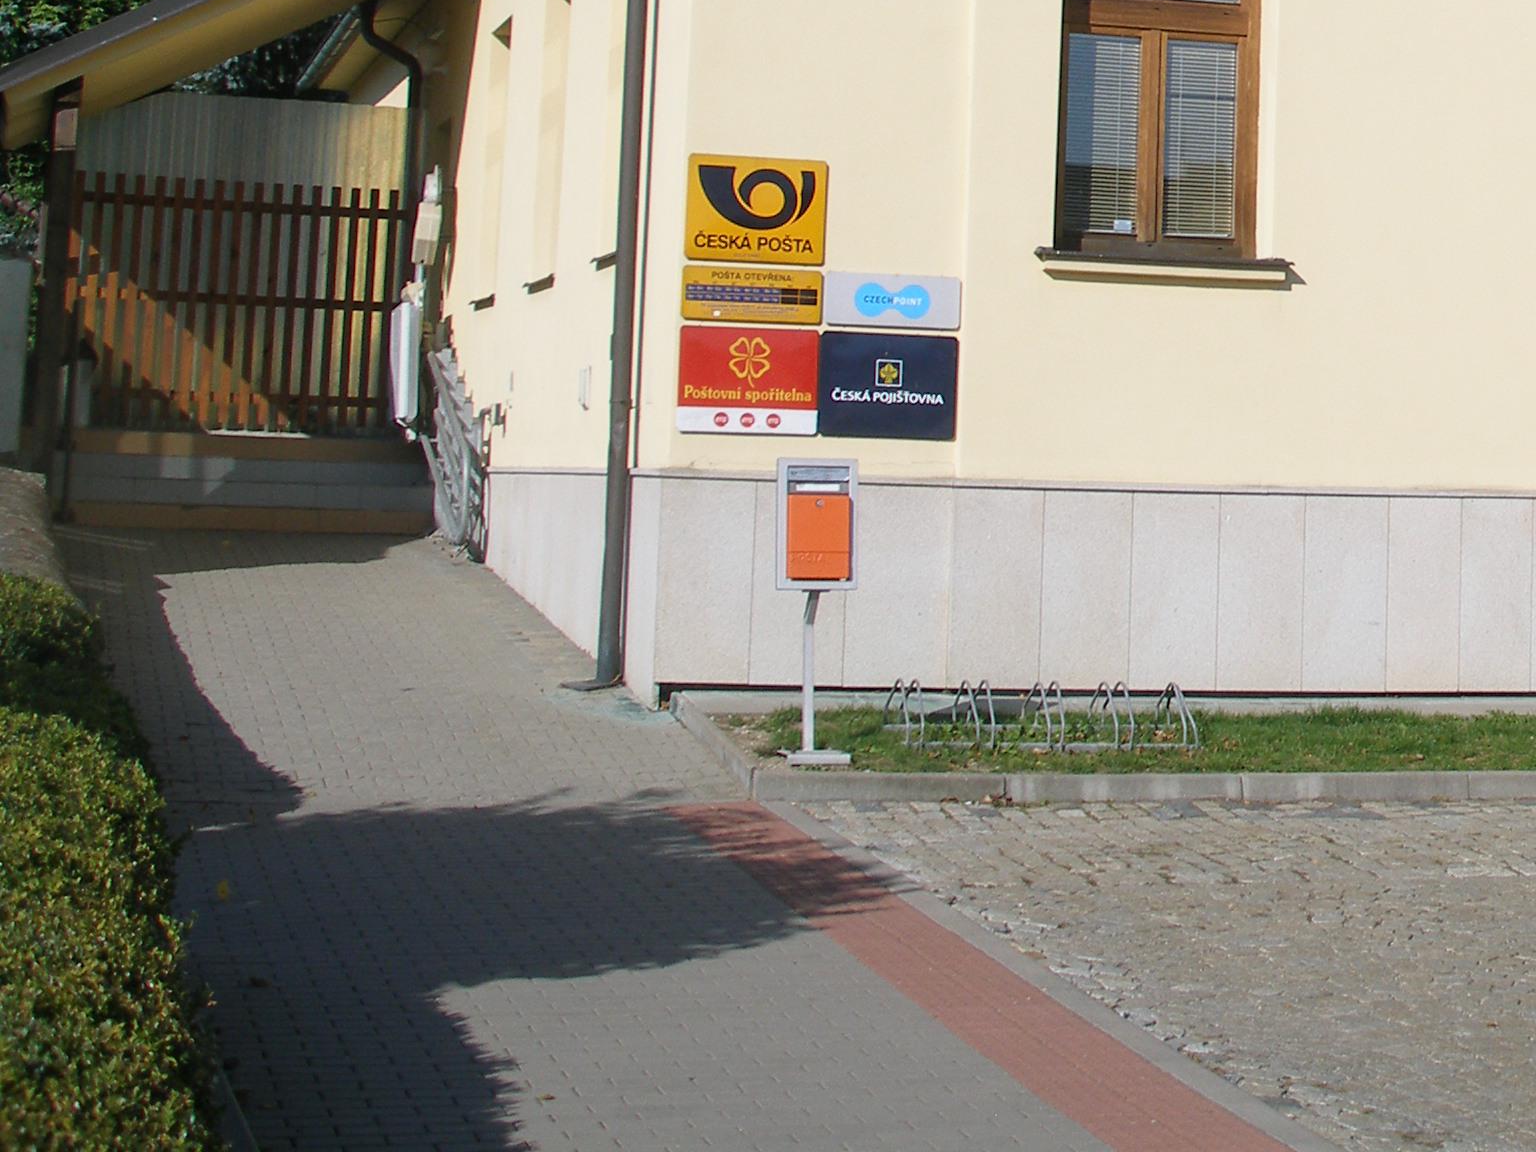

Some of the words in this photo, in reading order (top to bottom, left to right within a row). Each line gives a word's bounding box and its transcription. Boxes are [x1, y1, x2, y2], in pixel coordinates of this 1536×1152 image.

[694, 230, 752, 250] ČESKÁ
[757, 234, 814, 254] POŠTA
[711, 270, 742, 281] POŠTA
[743, 272, 792, 282] OTEVŘENA
[683, 384, 741, 400] Poštovní
[744, 388, 813, 404] spořitelna
[831, 386, 871, 402] ČESKÁ
[872, 390, 945, 405] POJIŠŤOVNA
